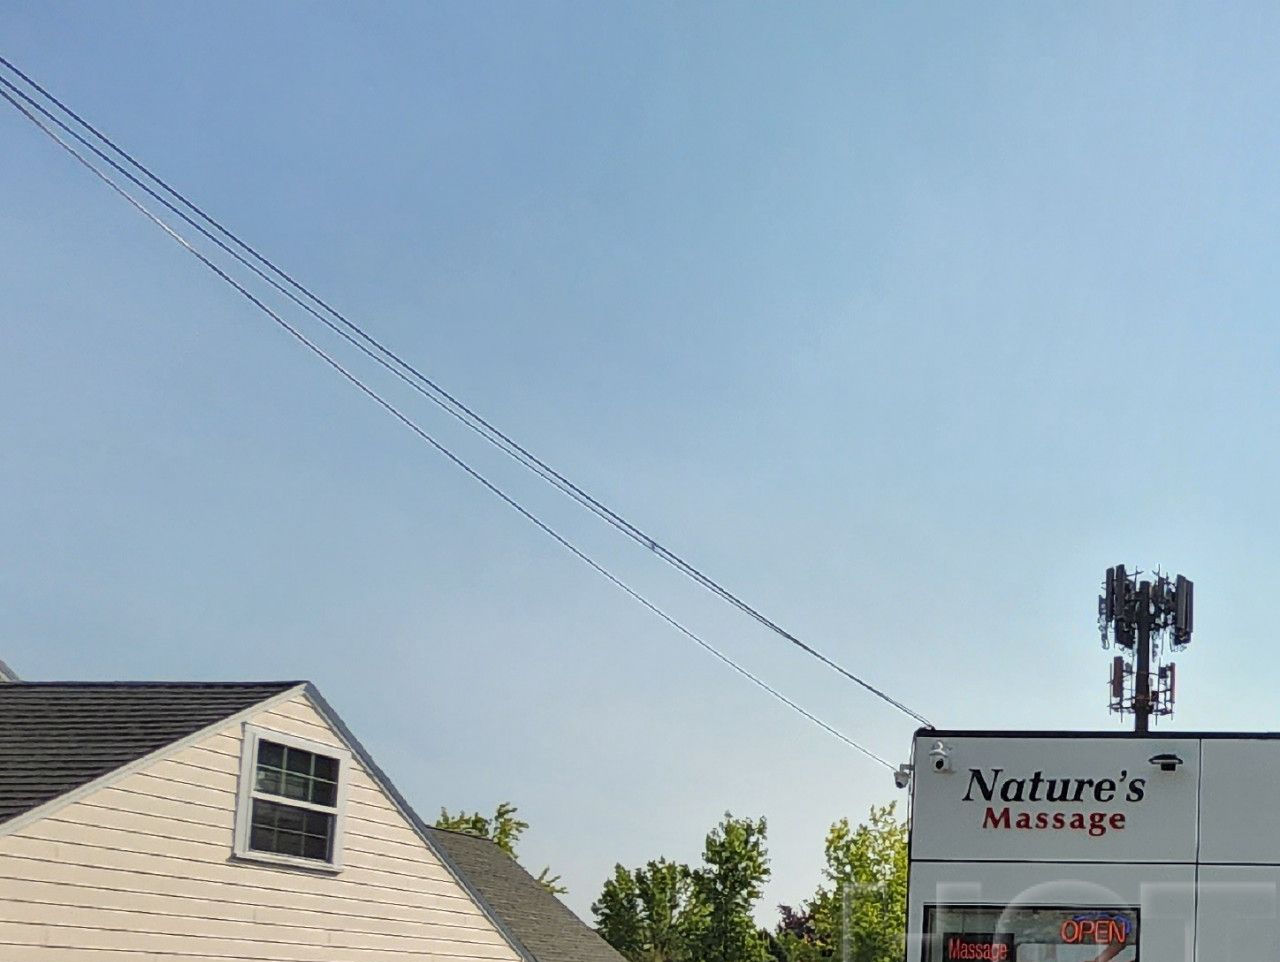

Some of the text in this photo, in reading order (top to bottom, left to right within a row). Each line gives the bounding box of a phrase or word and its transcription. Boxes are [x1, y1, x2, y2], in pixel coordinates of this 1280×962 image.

[962, 768, 1147, 802] Nature's
[982, 806, 1127, 837] Massage
[1061, 919, 1127, 944] OPEN
[949, 938, 1008, 962] Massage
